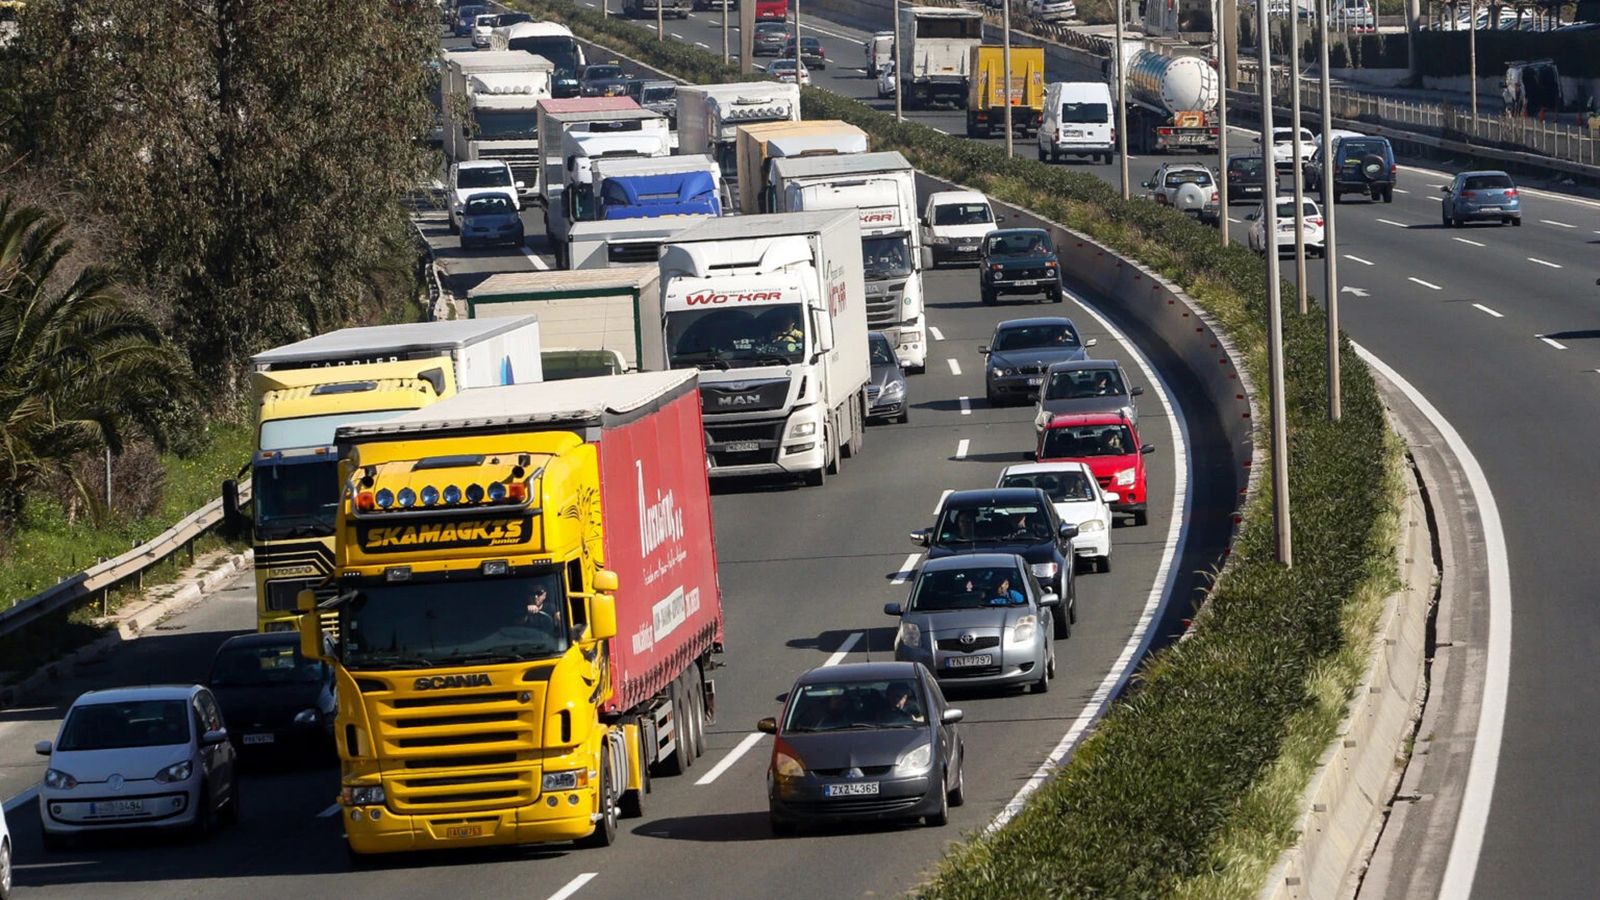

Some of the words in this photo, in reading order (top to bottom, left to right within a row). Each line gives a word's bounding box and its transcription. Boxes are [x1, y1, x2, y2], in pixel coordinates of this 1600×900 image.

[718, 394, 760, 406] MAN
[366, 519, 523, 548] SKAMAGKIS
[489, 537, 521, 546] junior
[272, 566, 313, 576] VOLVO
[415, 673, 492, 690] SCANIA
